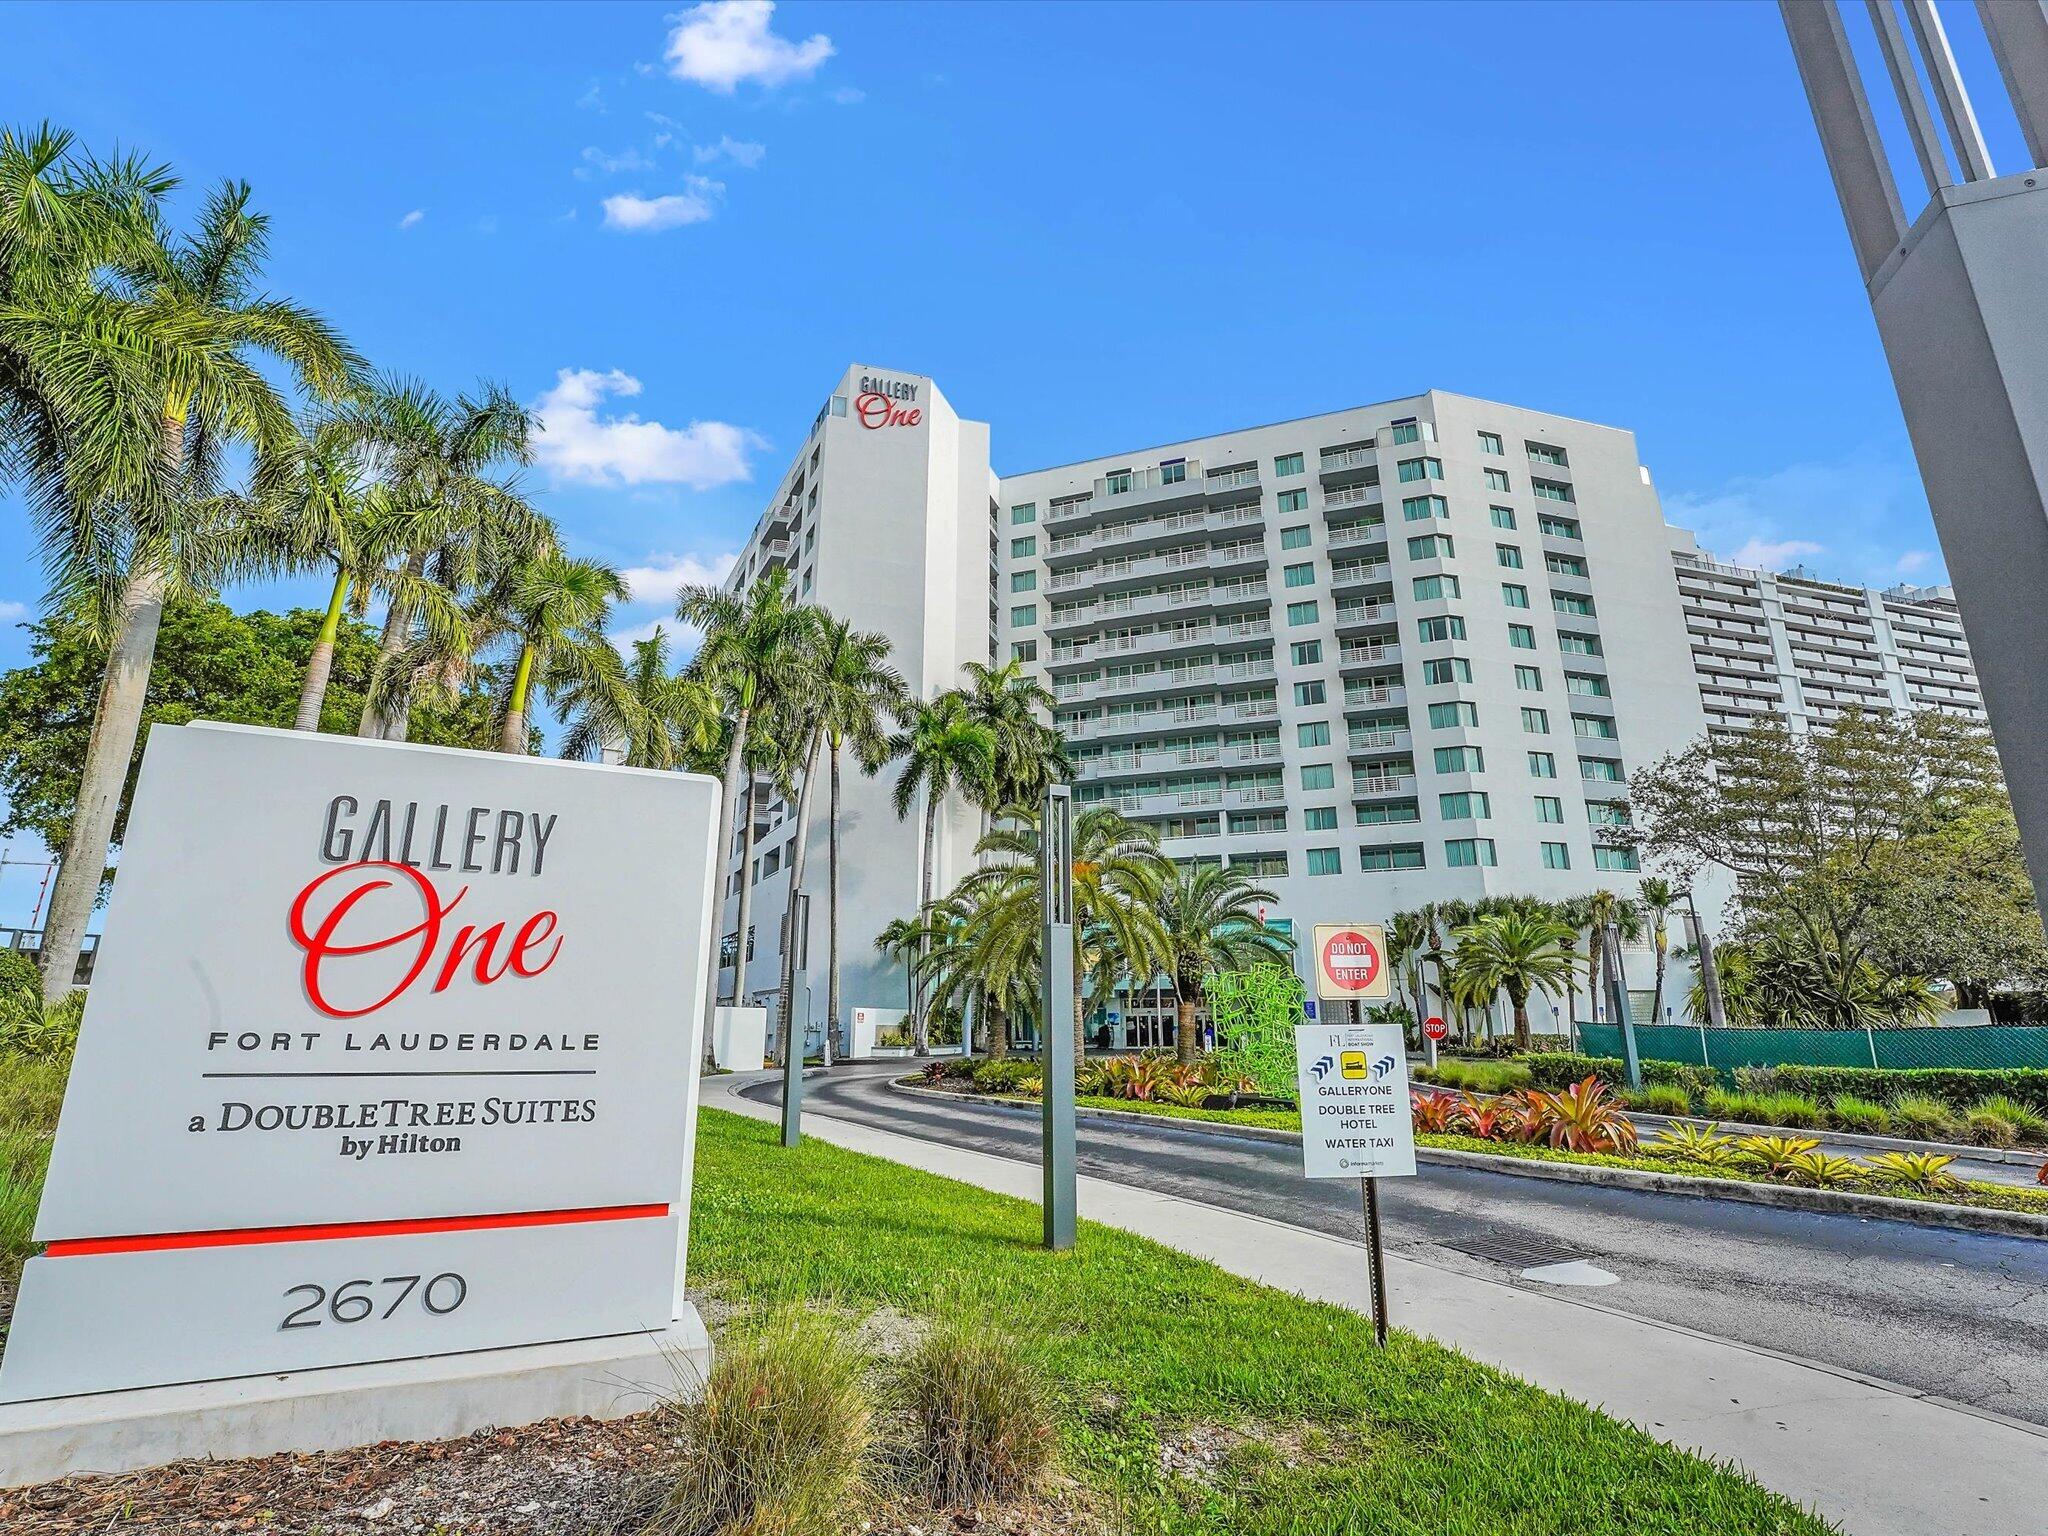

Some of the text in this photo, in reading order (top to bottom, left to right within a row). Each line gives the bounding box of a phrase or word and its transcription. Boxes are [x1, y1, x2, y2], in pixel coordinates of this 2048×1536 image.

[860, 375, 919, 402] GALLERY
[855, 392, 922, 430] One
[323, 795, 558, 875] GALLERY
[289, 860, 564, 1019] One
[1331, 942, 1368, 955] DO NOT
[1335, 967, 1369, 981] ENTER
[1425, 1022, 1446, 1034] STOP
[208, 1032, 600, 1051] FORT LAUDERDALE
[1318, 1085, 1392, 1096] GALLERYONE
[1318, 1104, 1395, 1115] DOUBLE TREE
[188, 1115, 206, 1133] a
[1340, 1119, 1378, 1129] HOTEL
[339, 1132, 461, 1161] by Hilton
[1325, 1137, 1394, 1149] WATER TAXI
[281, 1271, 468, 1330] 2670
